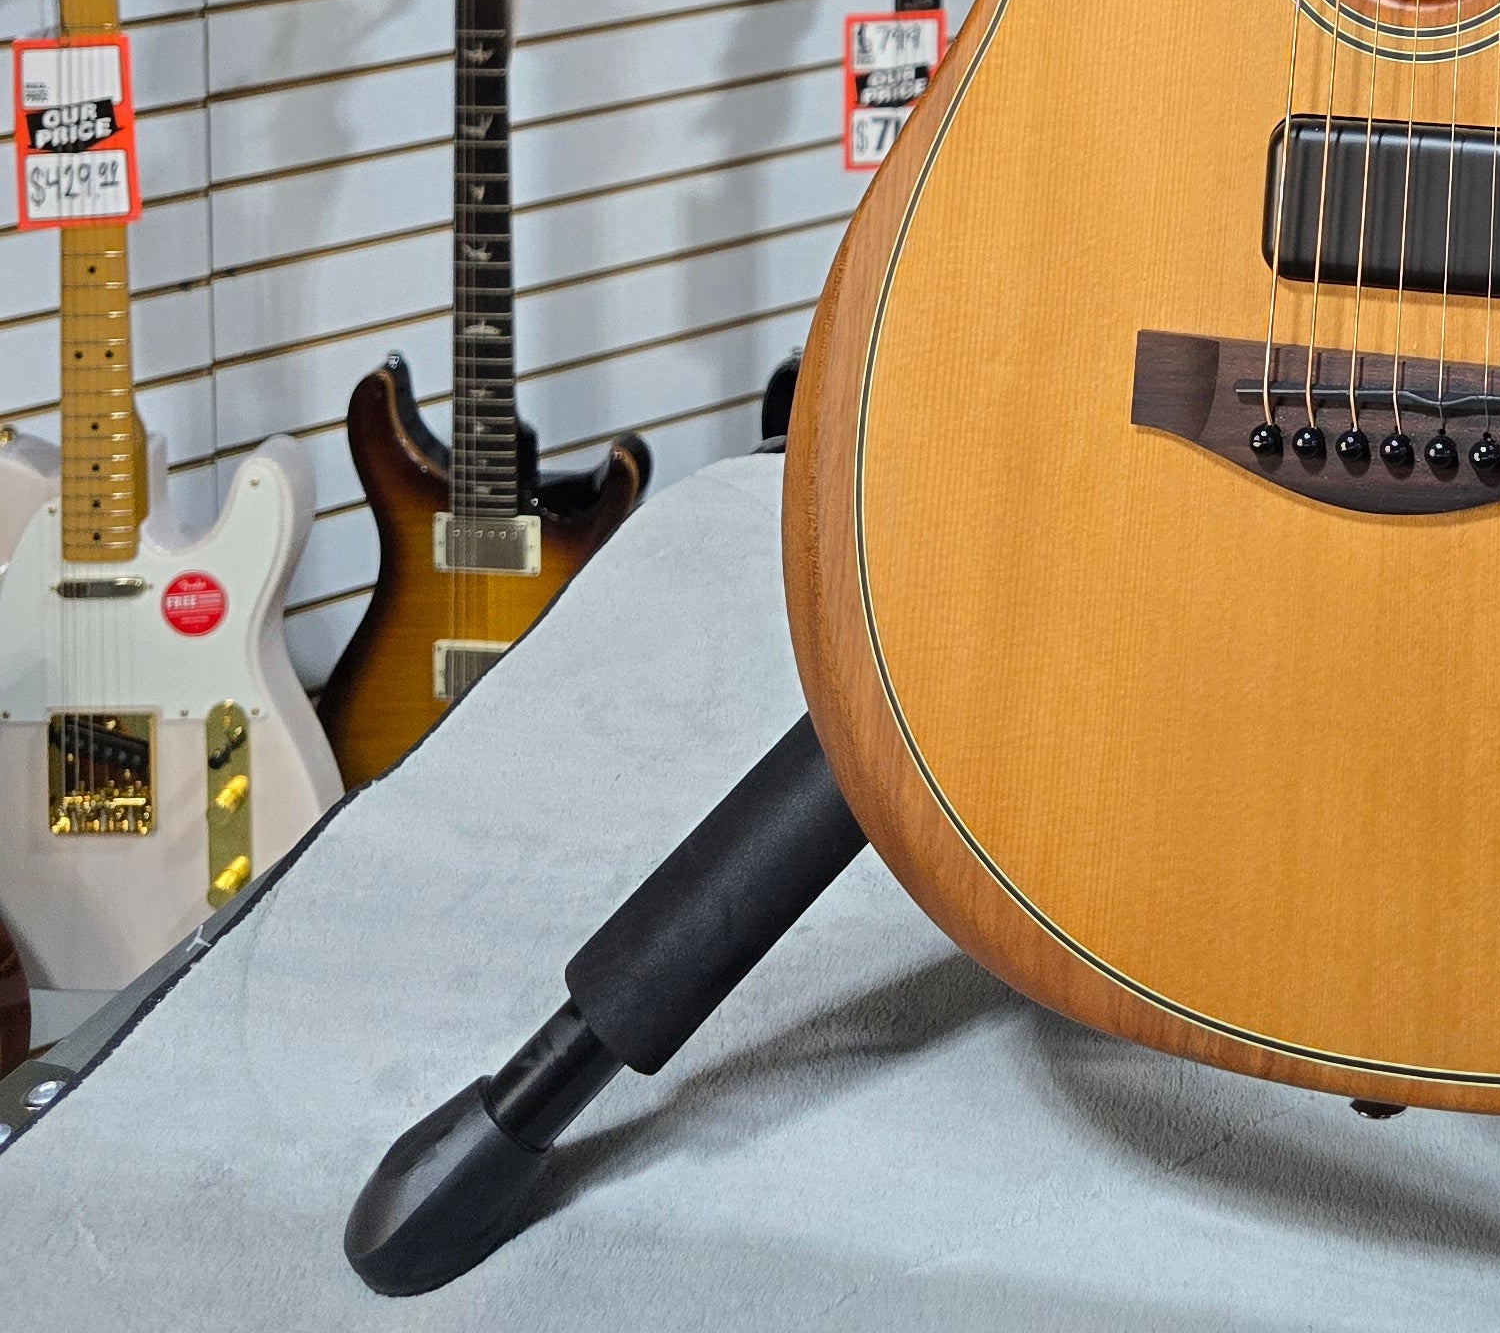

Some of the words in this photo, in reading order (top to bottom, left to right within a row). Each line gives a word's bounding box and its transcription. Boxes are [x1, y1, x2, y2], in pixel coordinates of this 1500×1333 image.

[42, 101, 98, 129] OUR
[34, 117, 113, 150] PRICE
[856, 116, 900, 155] $7
[166, 595, 197, 609] FREE
